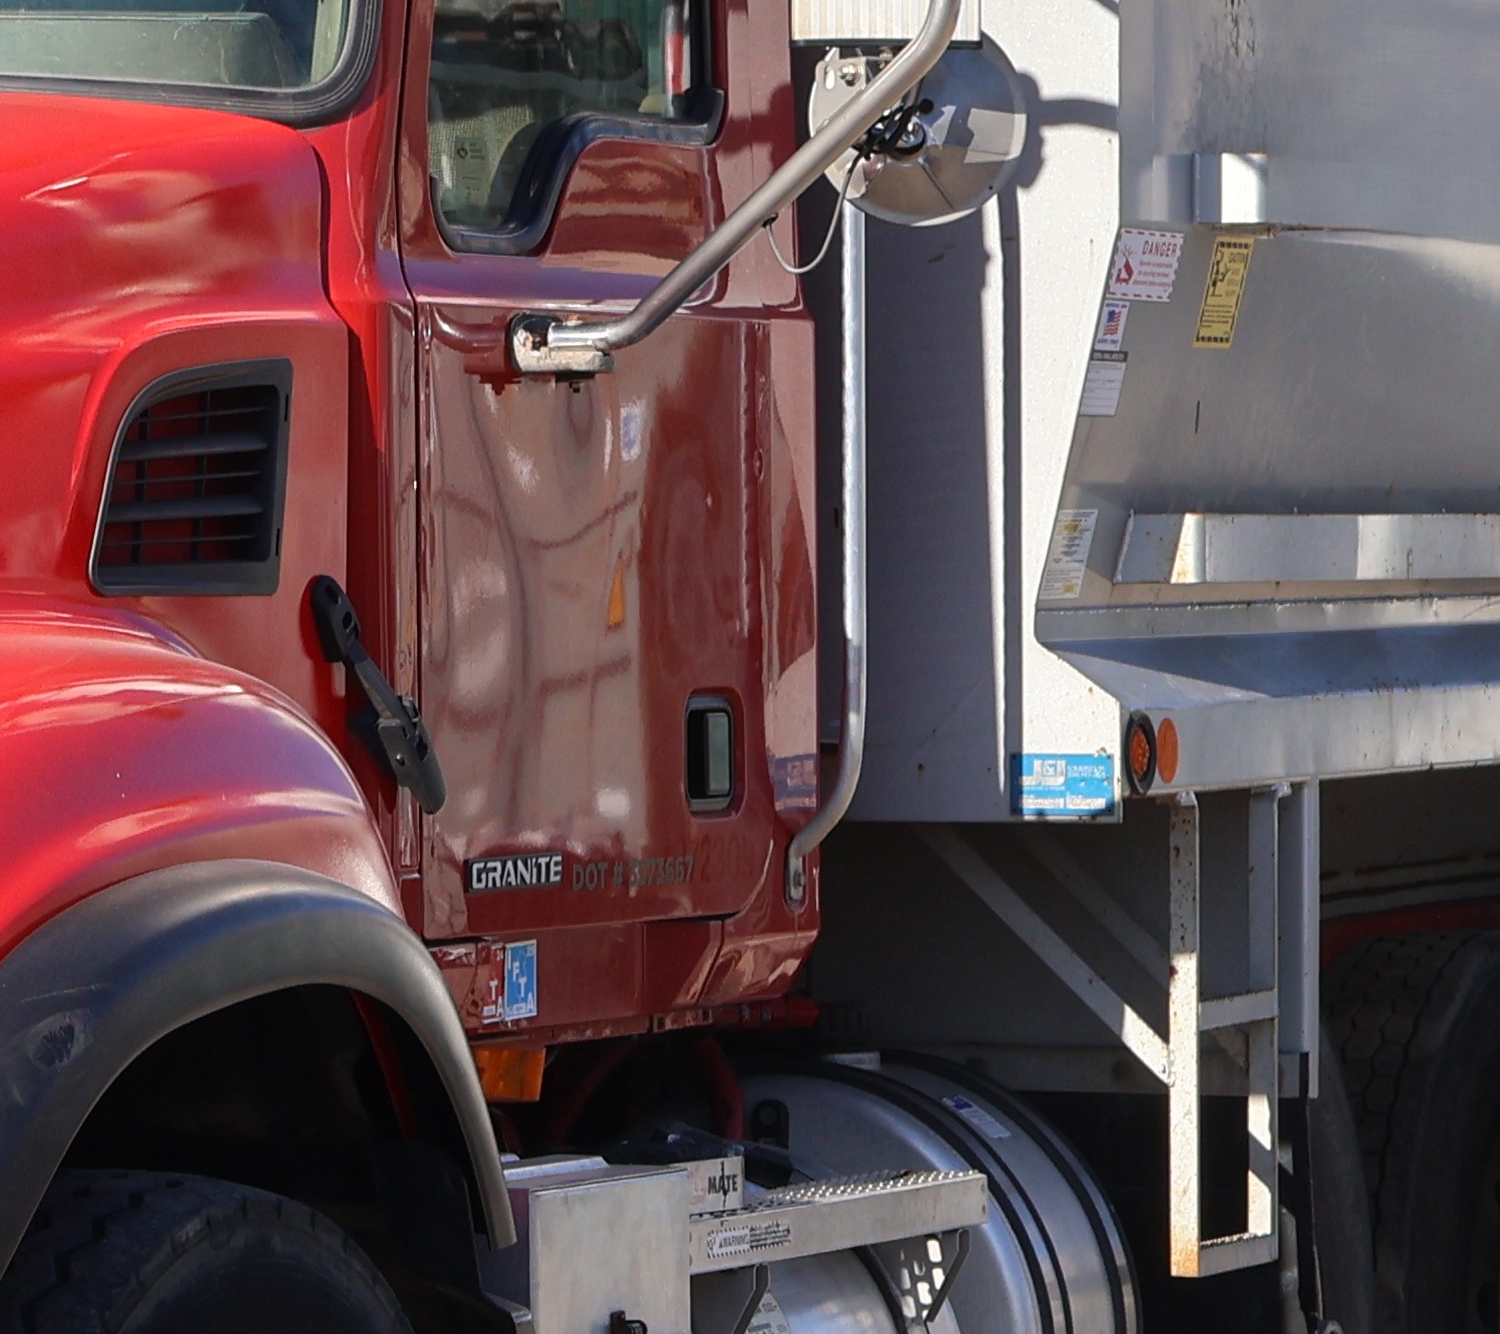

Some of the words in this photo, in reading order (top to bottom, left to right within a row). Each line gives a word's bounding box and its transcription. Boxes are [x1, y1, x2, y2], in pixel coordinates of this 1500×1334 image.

[1142, 240, 1178, 258] DANGER
[471, 855, 562, 890] GRANITE
[572, 862, 608, 892] DOT
[707, 1174, 738, 1195] MATE
